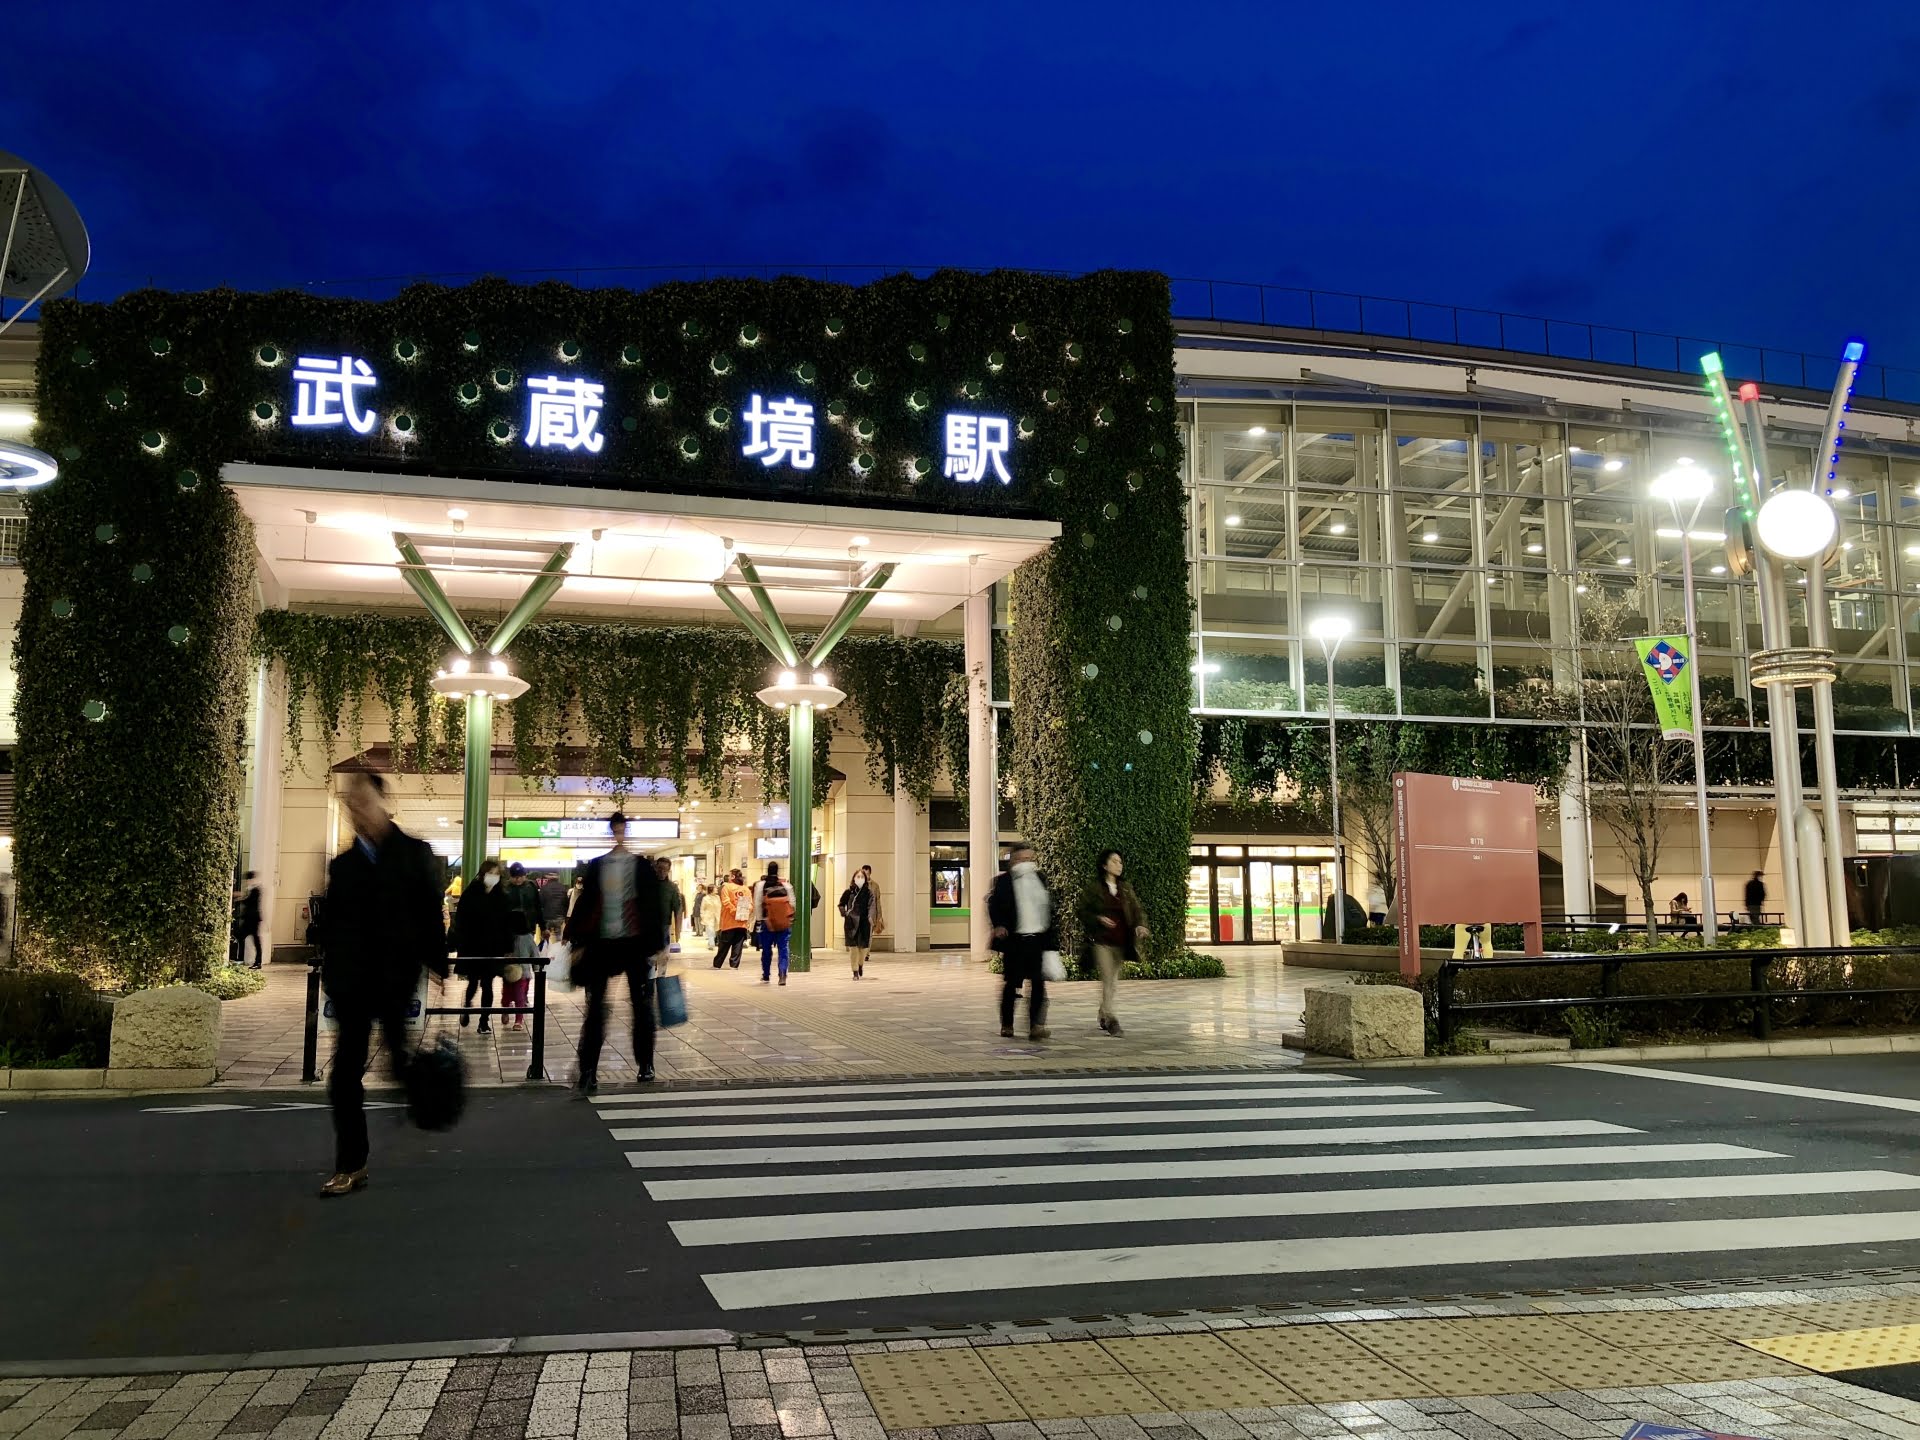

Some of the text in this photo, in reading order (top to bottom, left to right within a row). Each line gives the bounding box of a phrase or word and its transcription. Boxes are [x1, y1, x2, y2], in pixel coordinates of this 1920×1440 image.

[291, 356, 1012, 485] 武蔵境駅
[540, 821, 560, 833] JR
